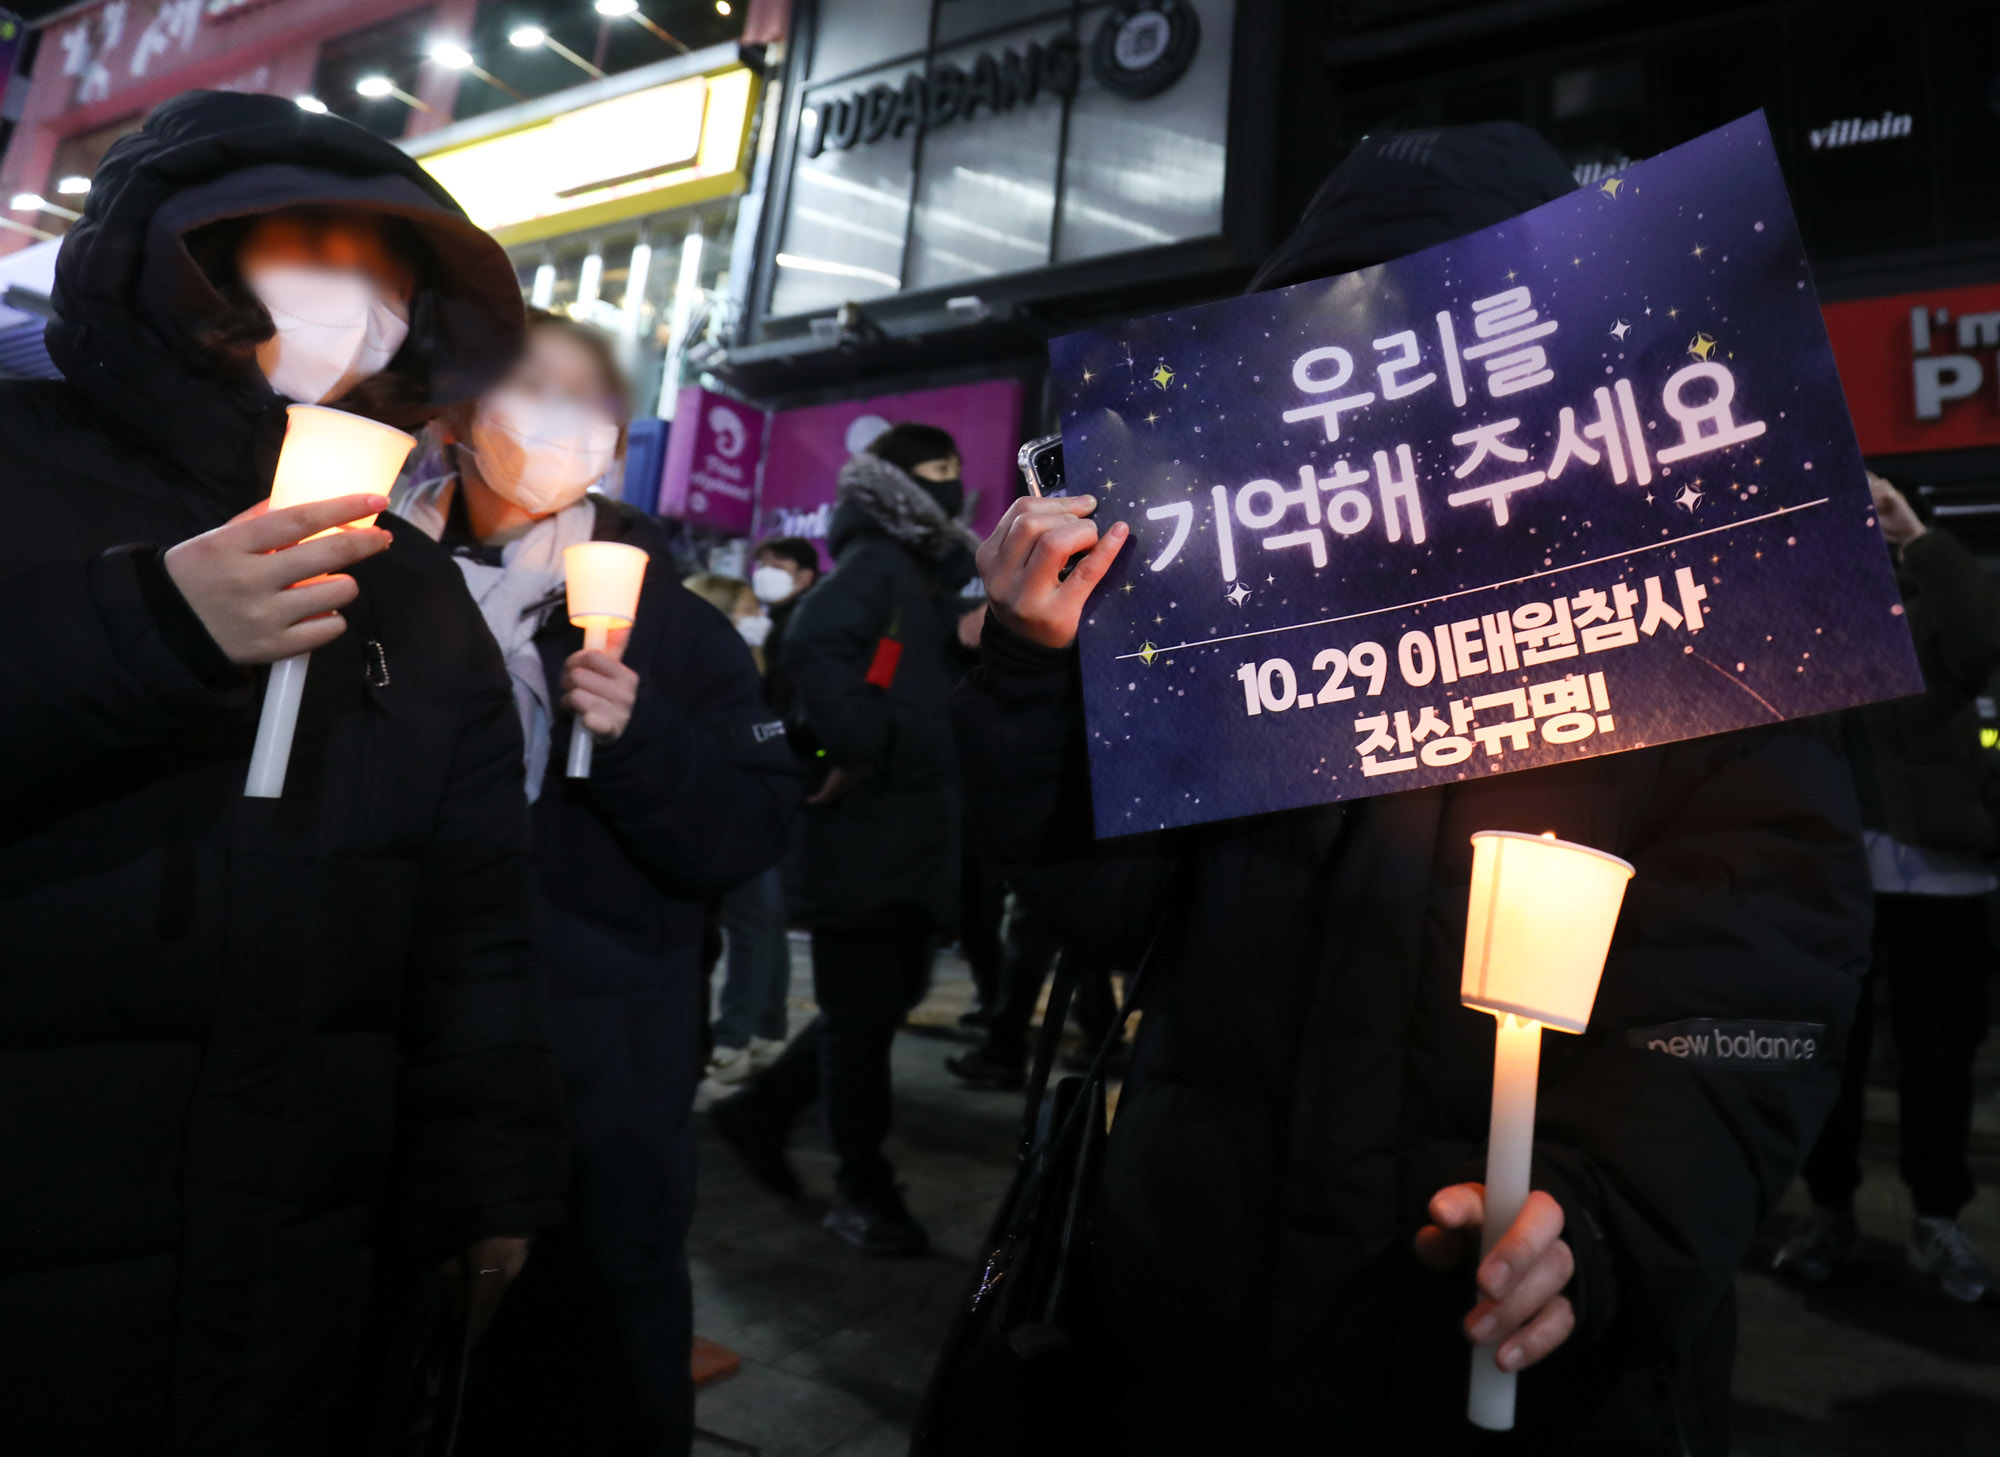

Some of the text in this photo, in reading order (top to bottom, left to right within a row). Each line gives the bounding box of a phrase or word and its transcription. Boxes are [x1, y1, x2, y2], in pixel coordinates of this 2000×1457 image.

[1809, 110, 1913, 150] villain
[1281, 285, 1559, 443] 우리를
[1145, 354, 1767, 583] 기억해 주세요
[1236, 566, 1708, 716] 10.29 이태원참사
[1353, 671, 1616, 778] 진상규명!
[1648, 1028, 1816, 1060] new balance
